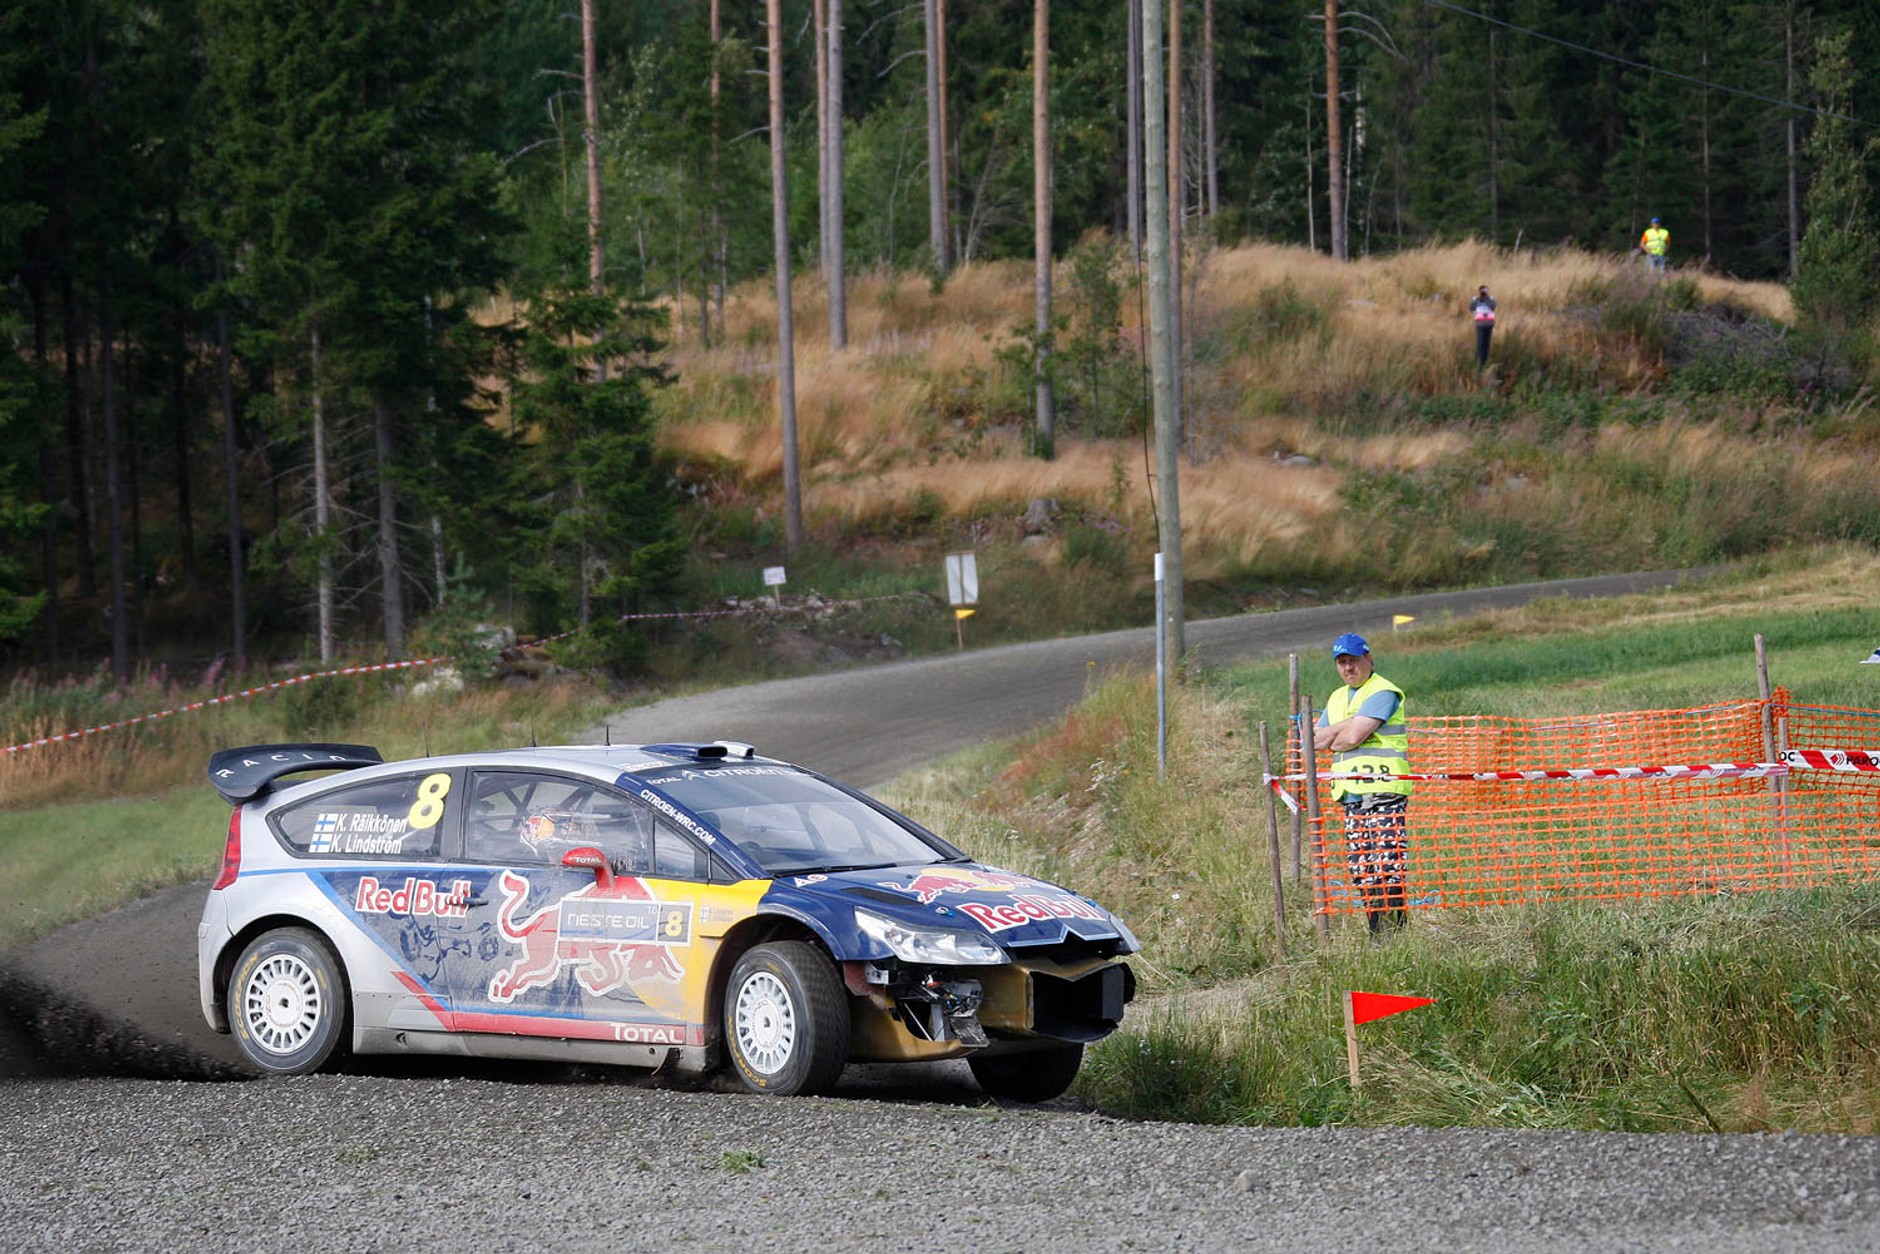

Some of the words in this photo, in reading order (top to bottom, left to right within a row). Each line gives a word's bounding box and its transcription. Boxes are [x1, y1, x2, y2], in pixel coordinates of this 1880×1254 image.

[408, 772, 452, 830] 8
[335, 813, 347, 832] K.
[349, 813, 408, 833] Räikkönen
[640, 789, 717, 846] CITROEN-WRC.COM
[330, 833, 342, 853] K.
[344, 833, 403, 855] Lindström
[625, 914, 650, 929] OIL
[665, 910, 683, 937] 8
[609, 1022, 683, 1044] TOTAL
